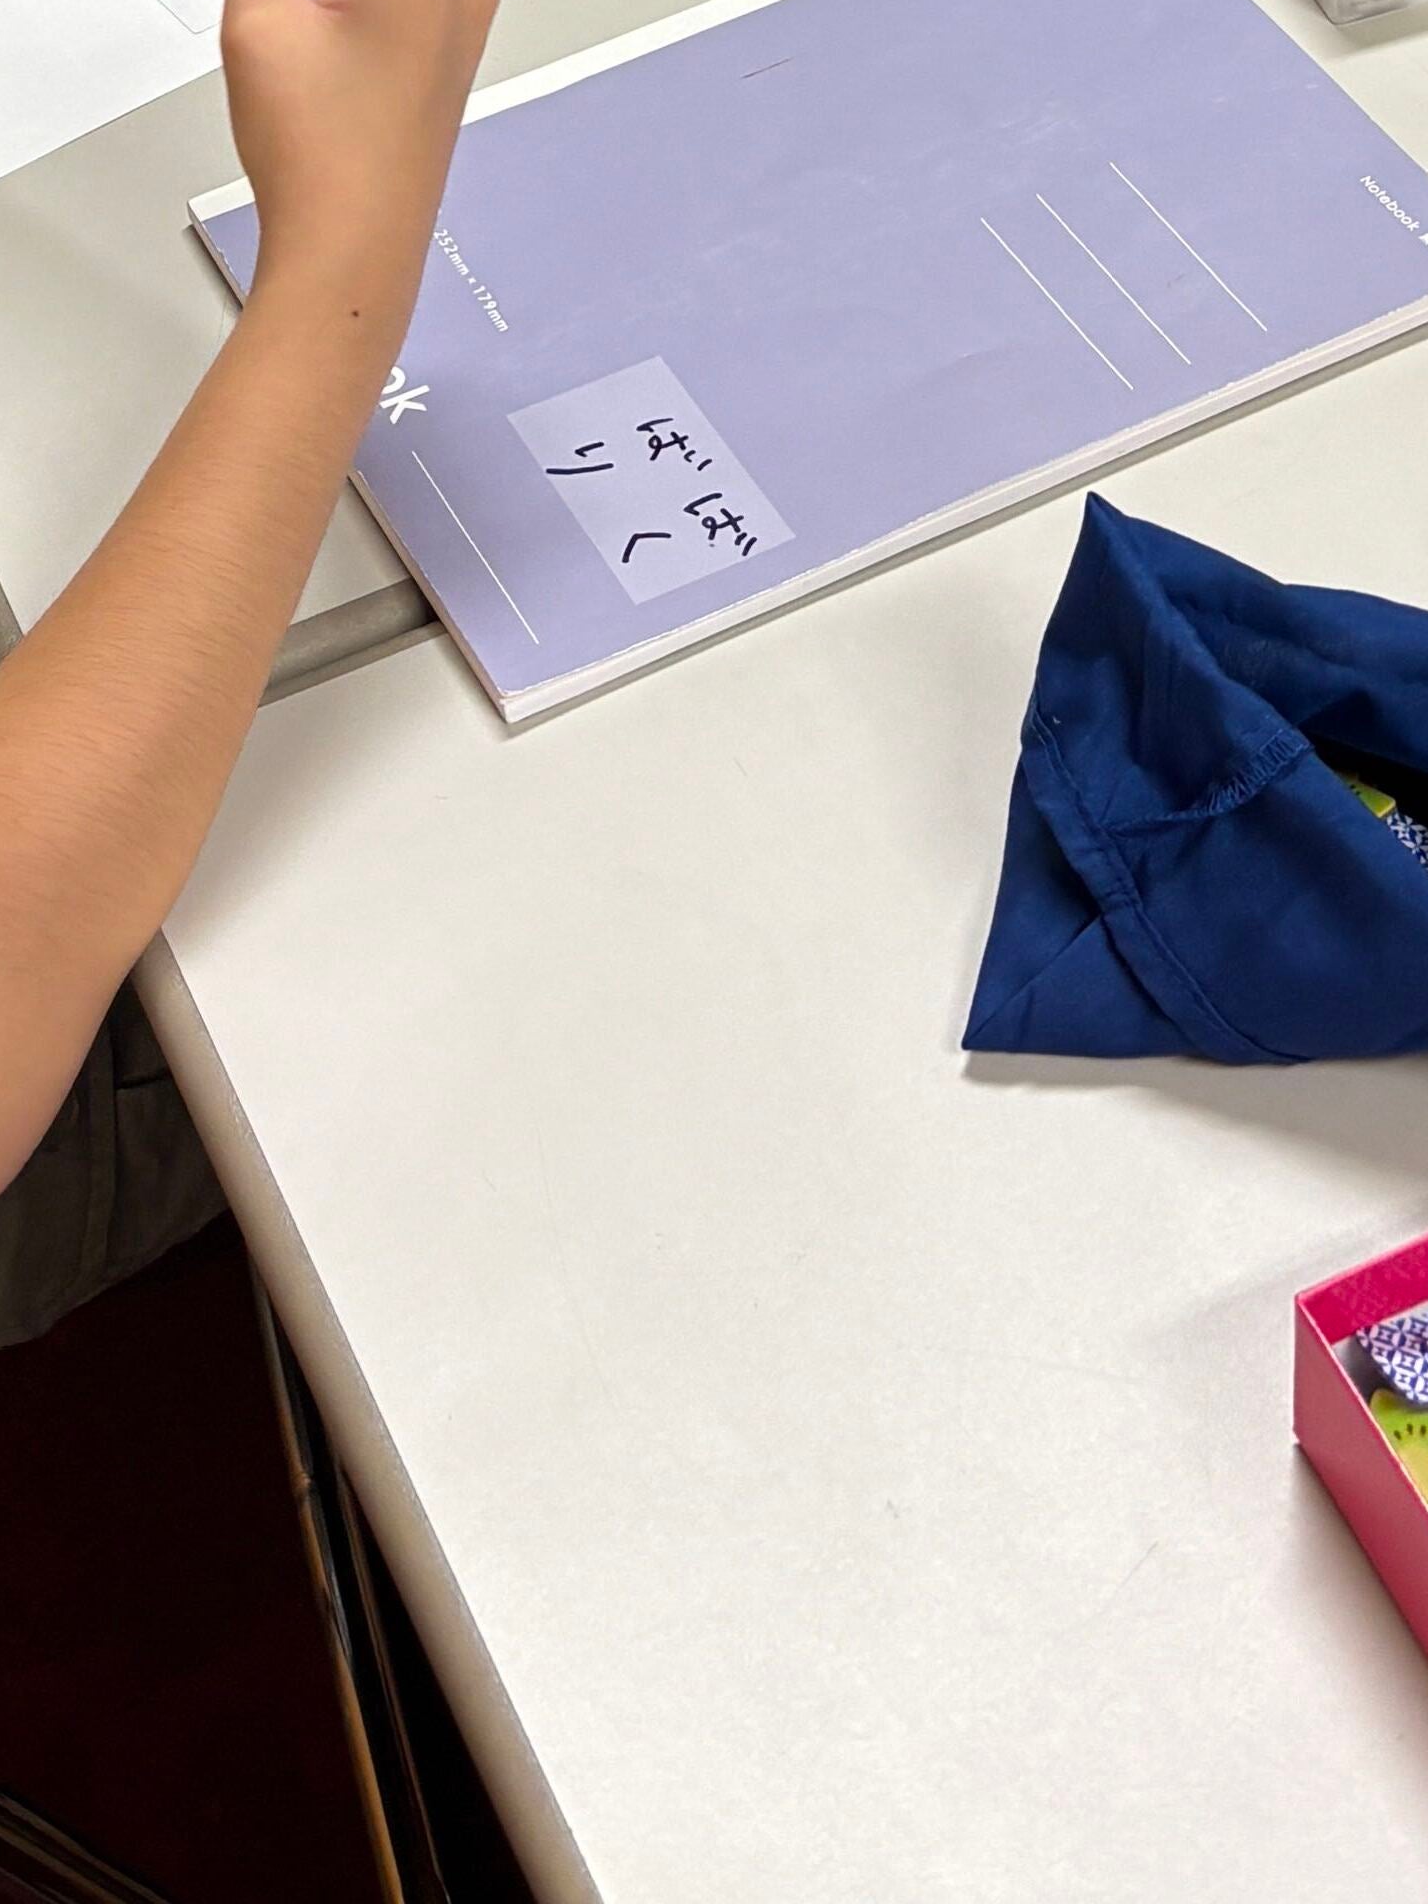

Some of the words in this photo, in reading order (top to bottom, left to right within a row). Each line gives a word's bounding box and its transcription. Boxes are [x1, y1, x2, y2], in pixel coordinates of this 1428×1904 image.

[1359, 174, 1421, 233] Notebook
[433, 228, 470, 278] 252mm
[472, 284, 509, 334] 179mm
[545, 441, 673, 564] りく
